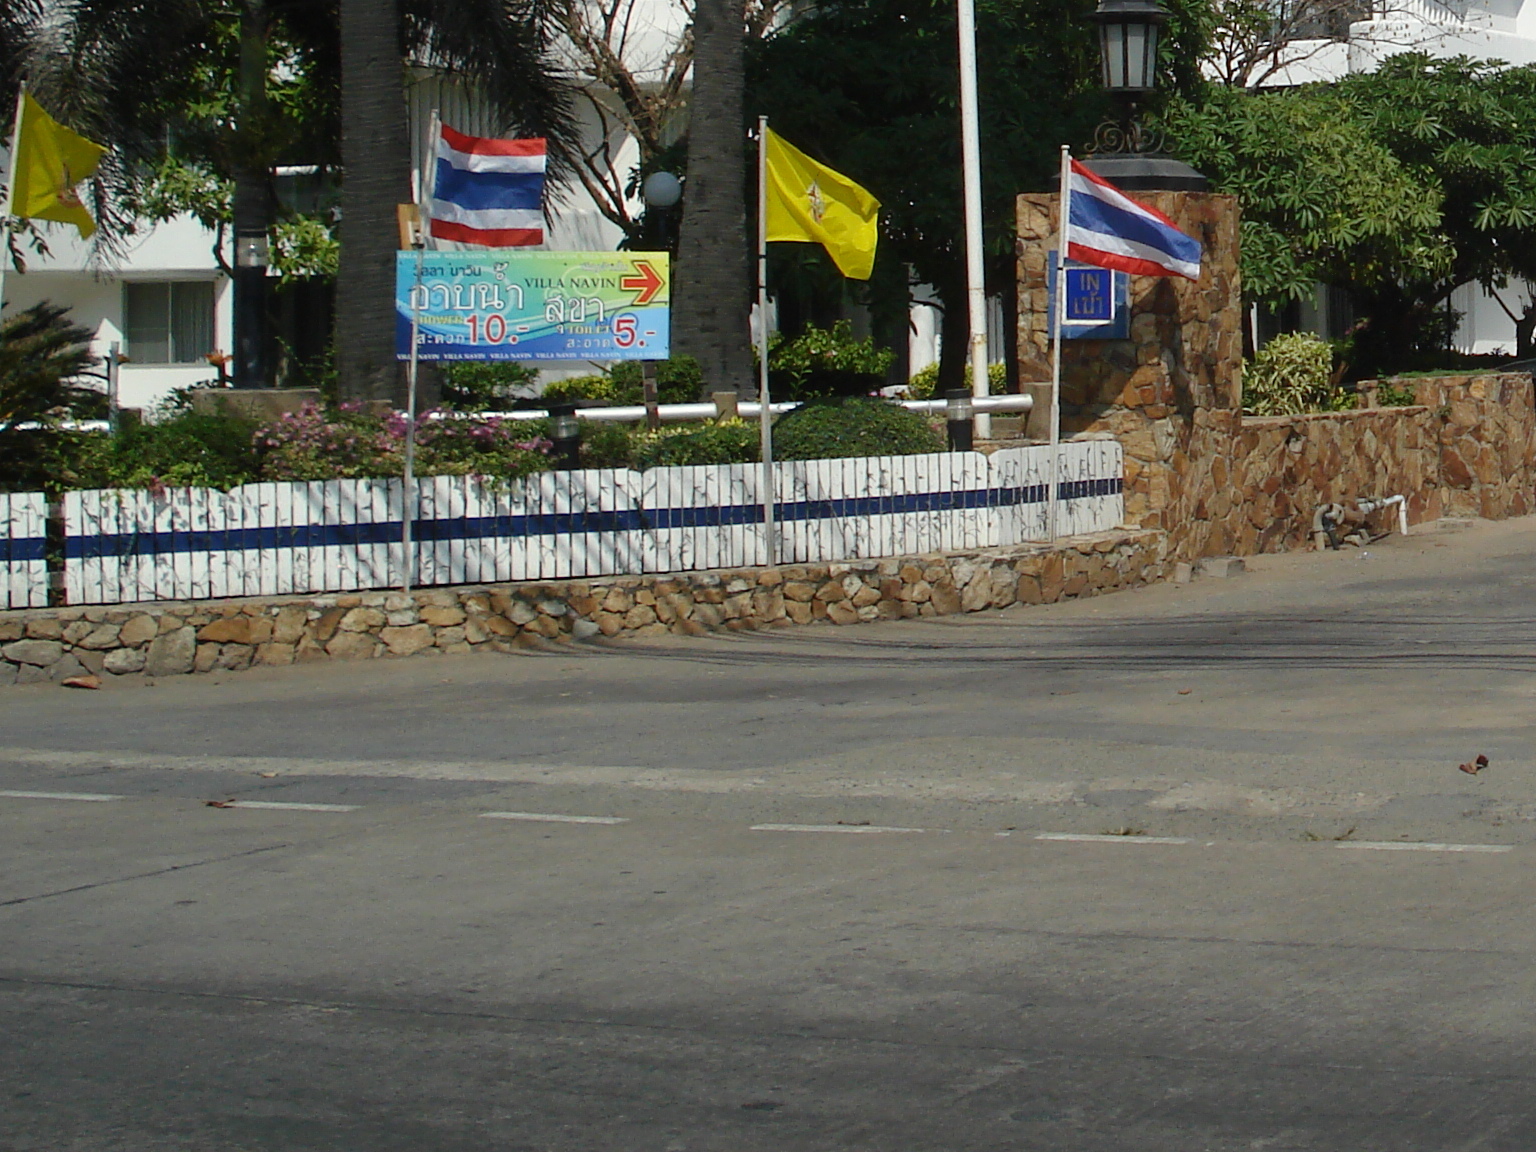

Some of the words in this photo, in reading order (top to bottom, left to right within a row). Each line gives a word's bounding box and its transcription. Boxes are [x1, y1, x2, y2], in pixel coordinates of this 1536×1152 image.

[409, 261, 524, 310] อาบน้ำ
[524, 277, 565, 288] VILLA
[570, 277, 616, 288] NAVIN
[1081, 273, 1099, 291] IN
[414, 315, 464, 325] HOWER
[544, 294, 604, 334] สุขา
